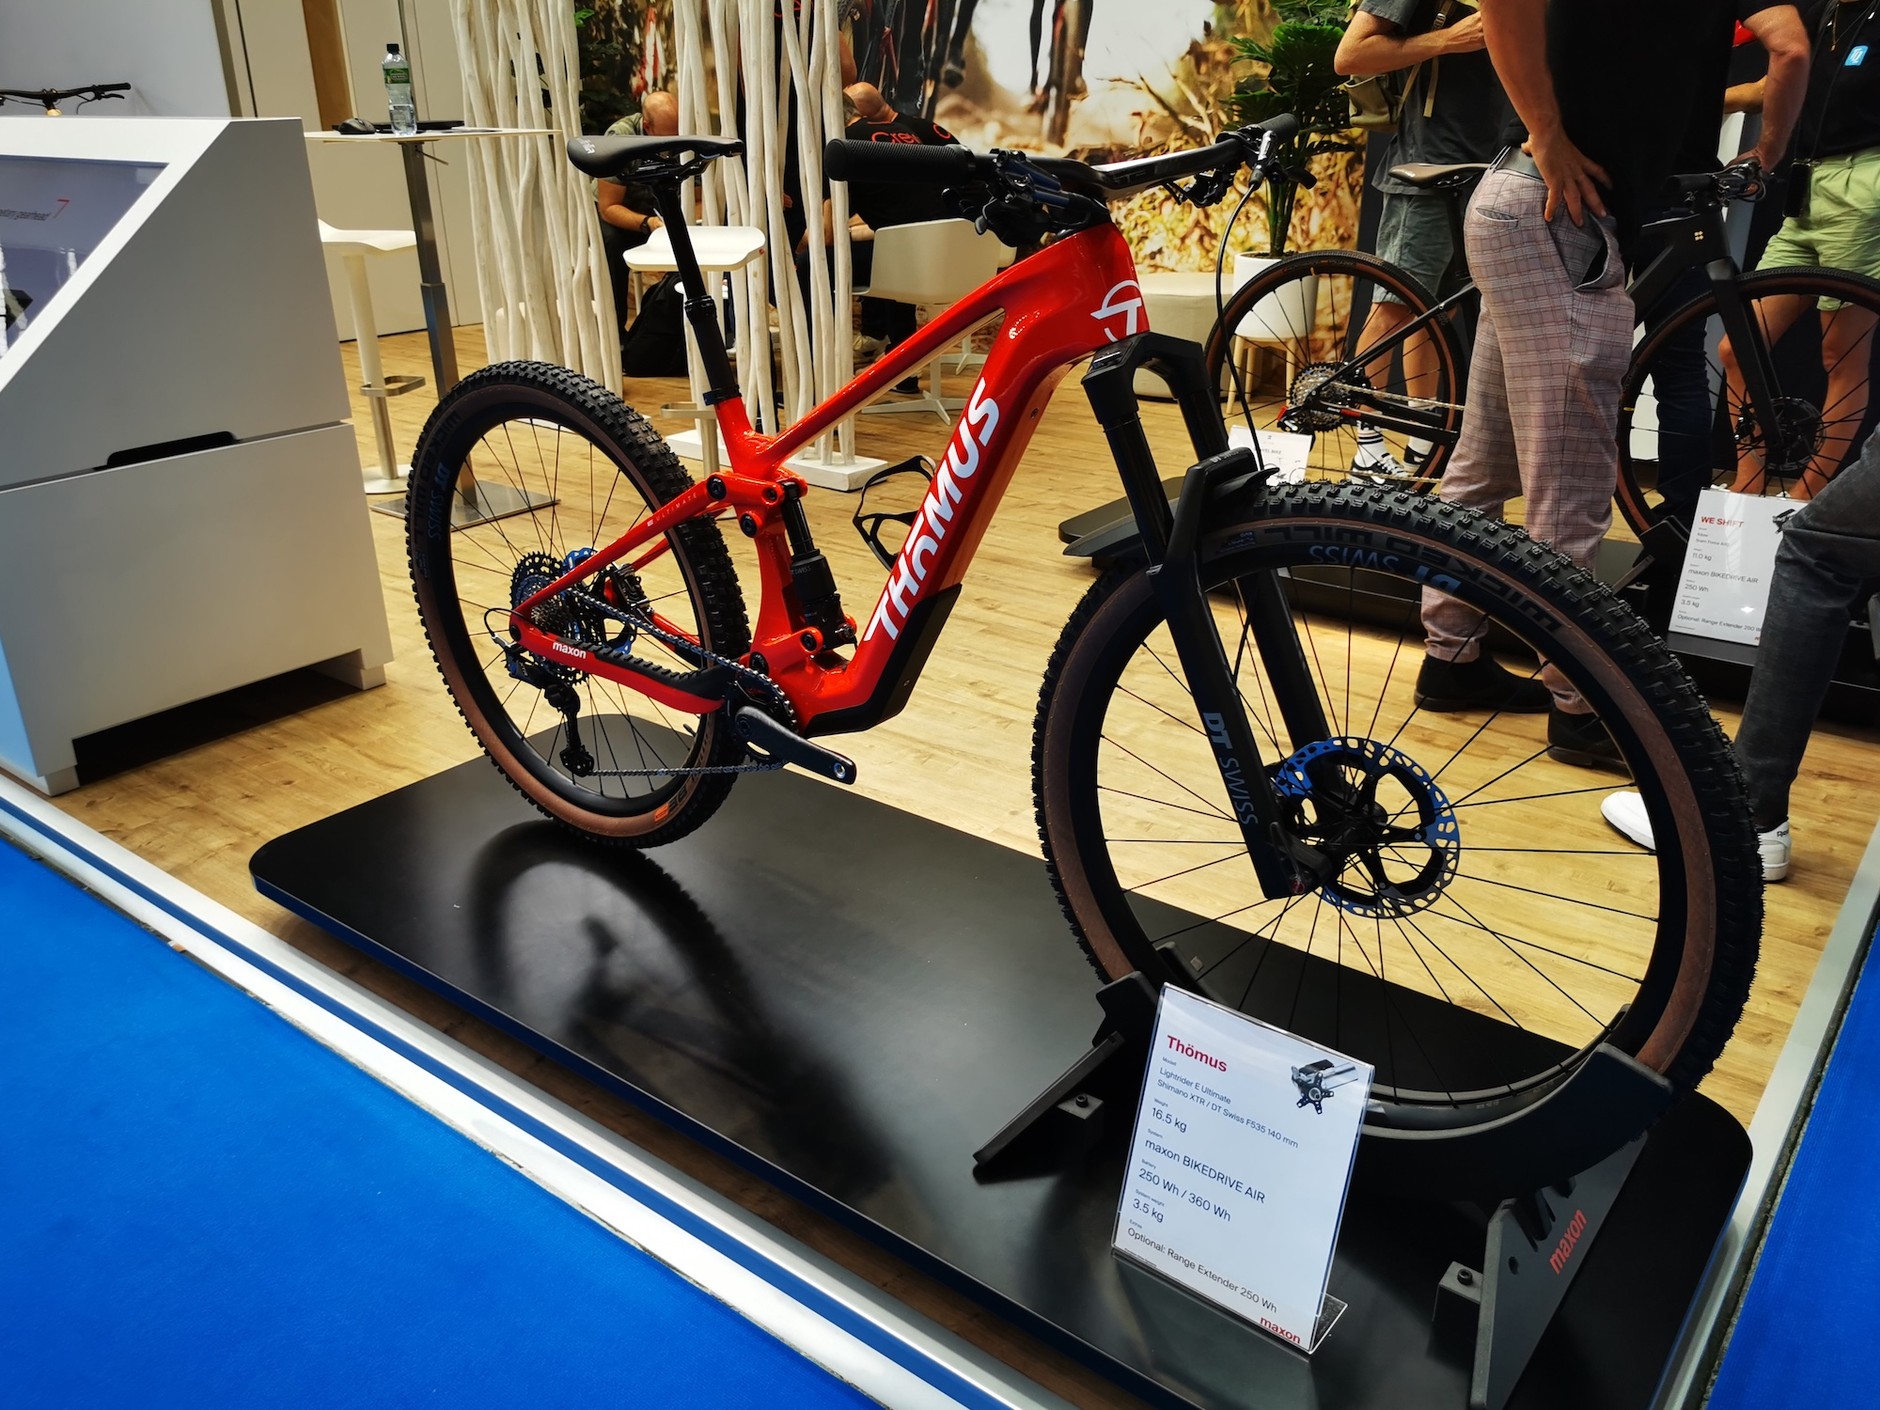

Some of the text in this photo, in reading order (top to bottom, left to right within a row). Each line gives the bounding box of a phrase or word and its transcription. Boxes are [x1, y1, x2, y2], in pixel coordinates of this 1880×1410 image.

[1701, 516, 1715, 526] WE
[1309, 545, 1463, 594] DT SWISS
[1685, 583, 1709, 593] 250 Wh
[1688, 568, 1709, 577] maxon
[1701, 617, 1718, 626] Range
[552, 641, 587, 660] maxon
[1203, 712, 1259, 825] DT SWISS
[1167, 1034, 1228, 1073] Thömus
[1160, 1067, 1232, 1105] Lightrider E Ultimate
[1152, 1107, 1188, 1134] 16.5 kg
[1157, 1078, 1189, 1099] Shimano
[1189, 1092, 1206, 1106] XTR
[1211, 1102, 1222, 1113] DT
[1222, 1108, 1245, 1124] Swiss
[1245, 1118, 1266, 1134] F535
[1267, 1128, 1282, 1141] 140
[1282, 1136, 1299, 1149] mm
[1145, 1139, 1266, 1204] maxon BIKEDRIVE AIR
[1132, 1198, 1164, 1224] 3.5 kg
[1138, 1167, 1161, 1186] 250
[1162, 1178, 1180, 1197] Wh
[1187, 1192, 1212, 1212] 360
[1213, 1204, 1232, 1222] Wh
[1549, 1208, 1588, 1275] maxon
[1127, 1227, 1166, 1254] Optional:
[1167, 1247, 1196, 1270] Range
[1197, 1264, 1239, 1292] Extender
[1239, 1286, 1260, 1303] 250
[1261, 1297, 1277, 1314] Wh
[1260, 1316, 1301, 1345] maxon
